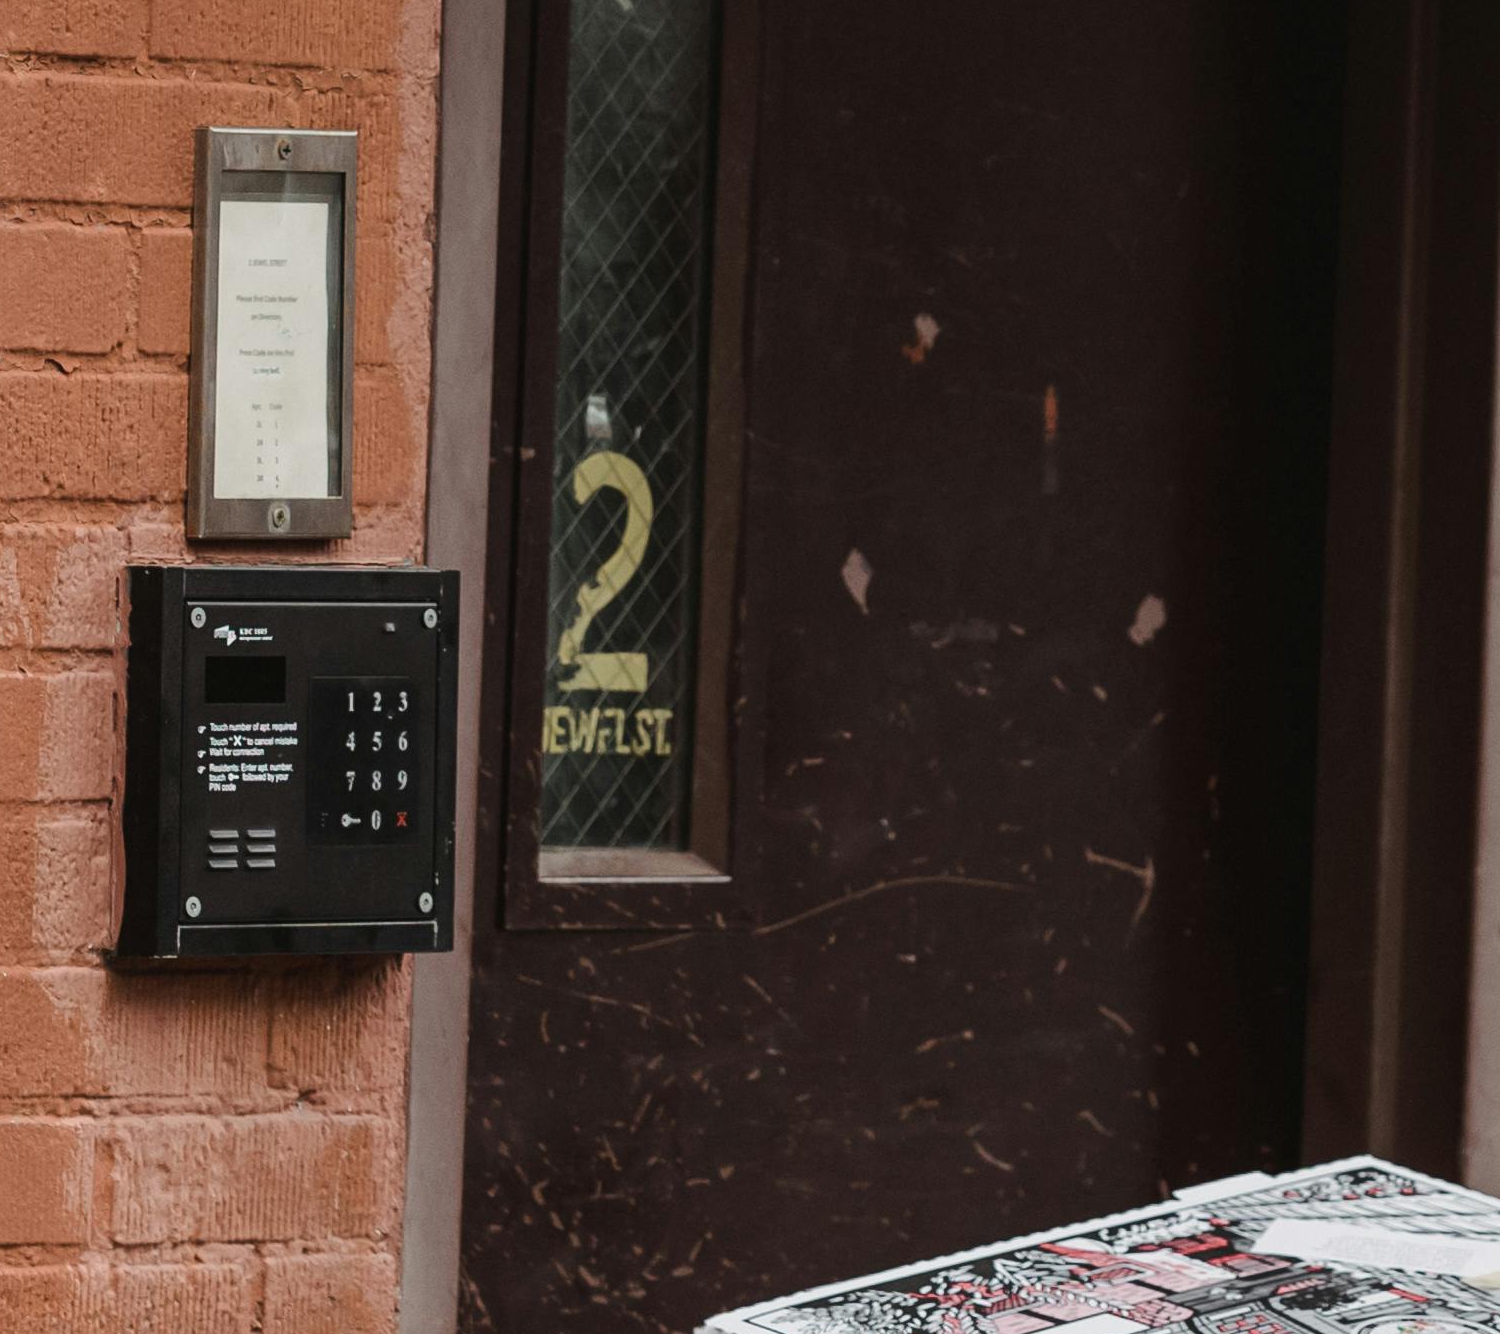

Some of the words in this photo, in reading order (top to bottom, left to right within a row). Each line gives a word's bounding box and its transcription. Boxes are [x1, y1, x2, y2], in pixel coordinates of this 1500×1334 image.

[557, 451, 653, 692] 2
[347, 692, 355, 711] 1
[373, 691, 382, 711] 2
[398, 691, 408, 712] 3
[228, 723, 251, 731] number
[271, 722, 298, 732] required
[254, 737, 274, 745] cancel
[274, 737, 298, 745] mistake
[346, 731, 356, 751] 4
[372, 731, 382, 751] 5
[398, 731, 408, 751] 6
[209, 783, 221, 791] PIN
[221, 783, 237, 791] code
[346, 771, 356, 791] 7
[372, 770, 381, 791] 8
[397, 770, 408, 790] 9
[371, 810, 381, 830] 0
